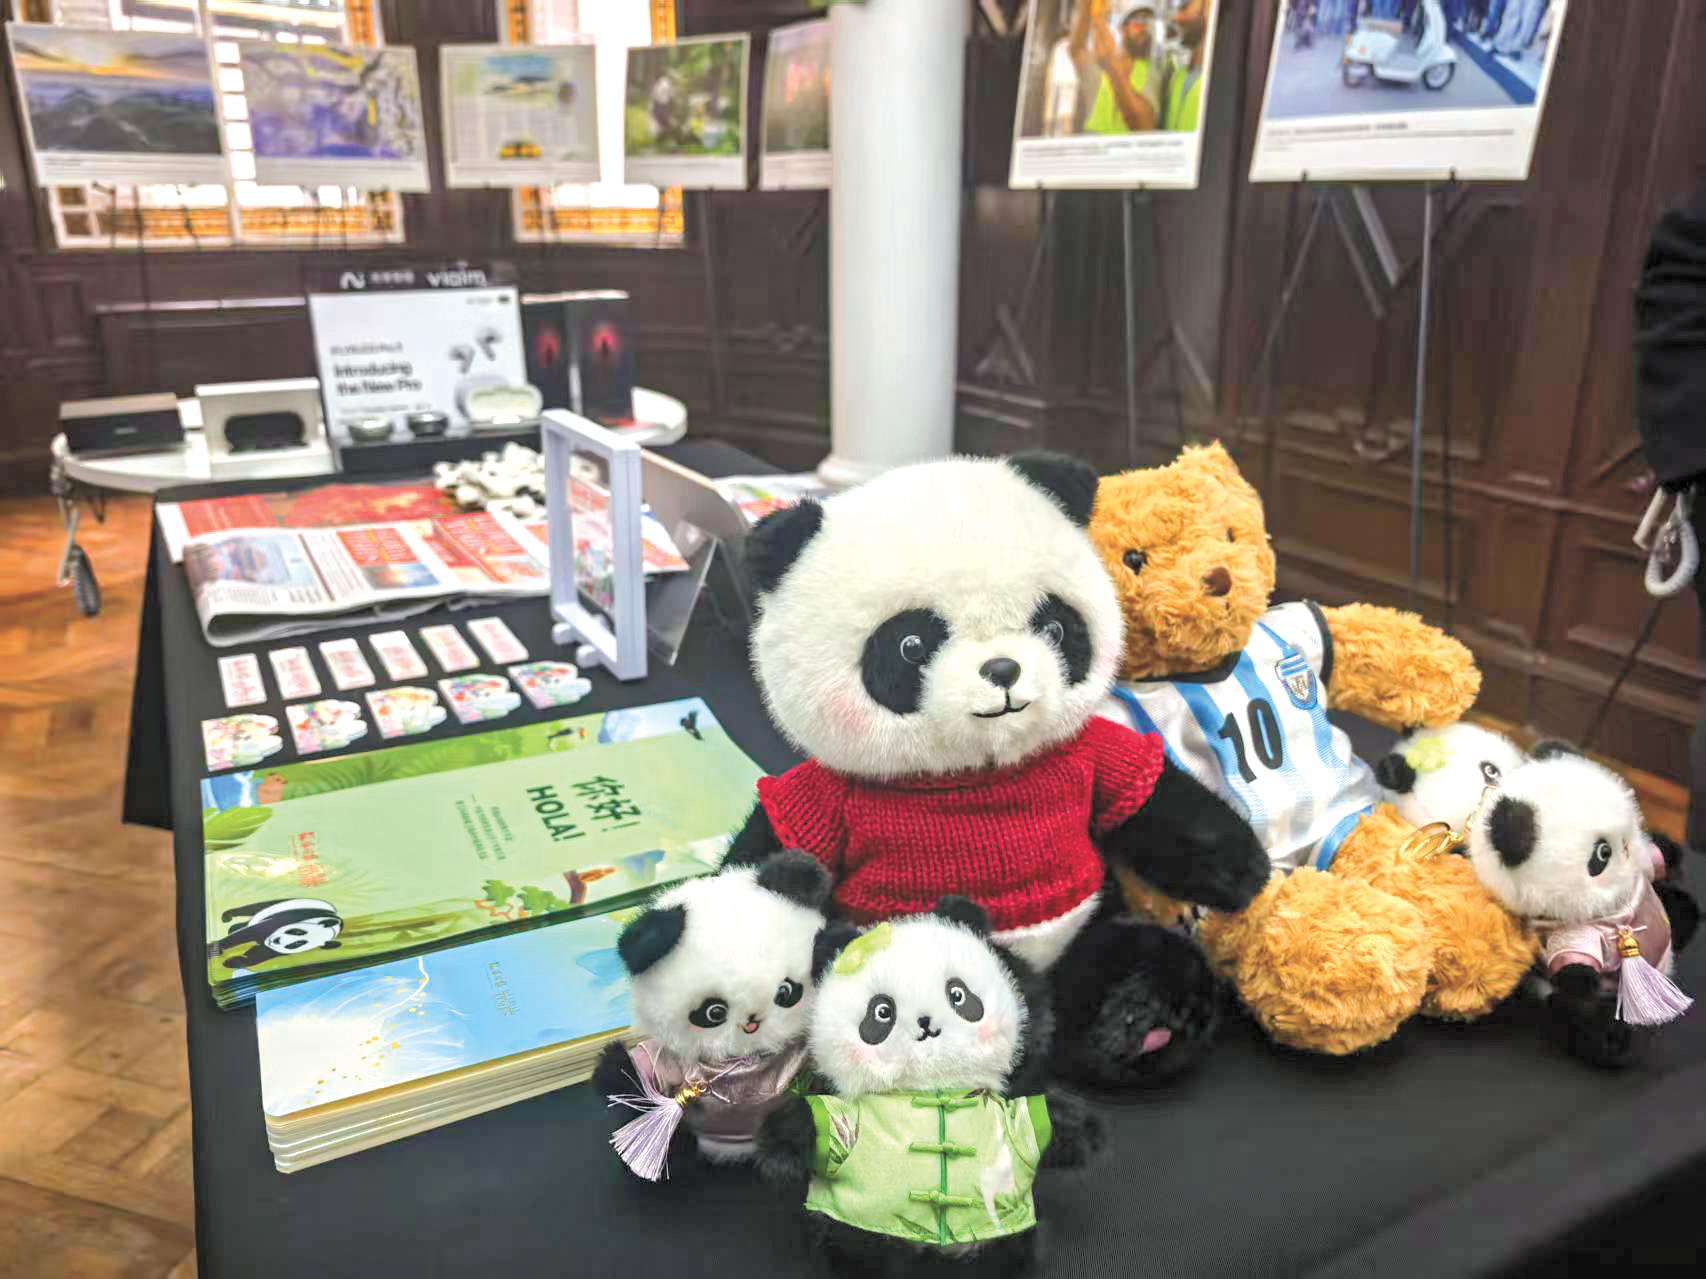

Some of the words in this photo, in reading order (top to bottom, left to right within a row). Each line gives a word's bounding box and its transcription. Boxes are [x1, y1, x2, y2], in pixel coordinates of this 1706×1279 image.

[334, 361, 413, 378] Introducing
[336, 380, 360, 396] the
[397, 378, 422, 392] Pro
[1218, 697, 1283, 784] 10
[526, 784, 586, 842] HOLA!
